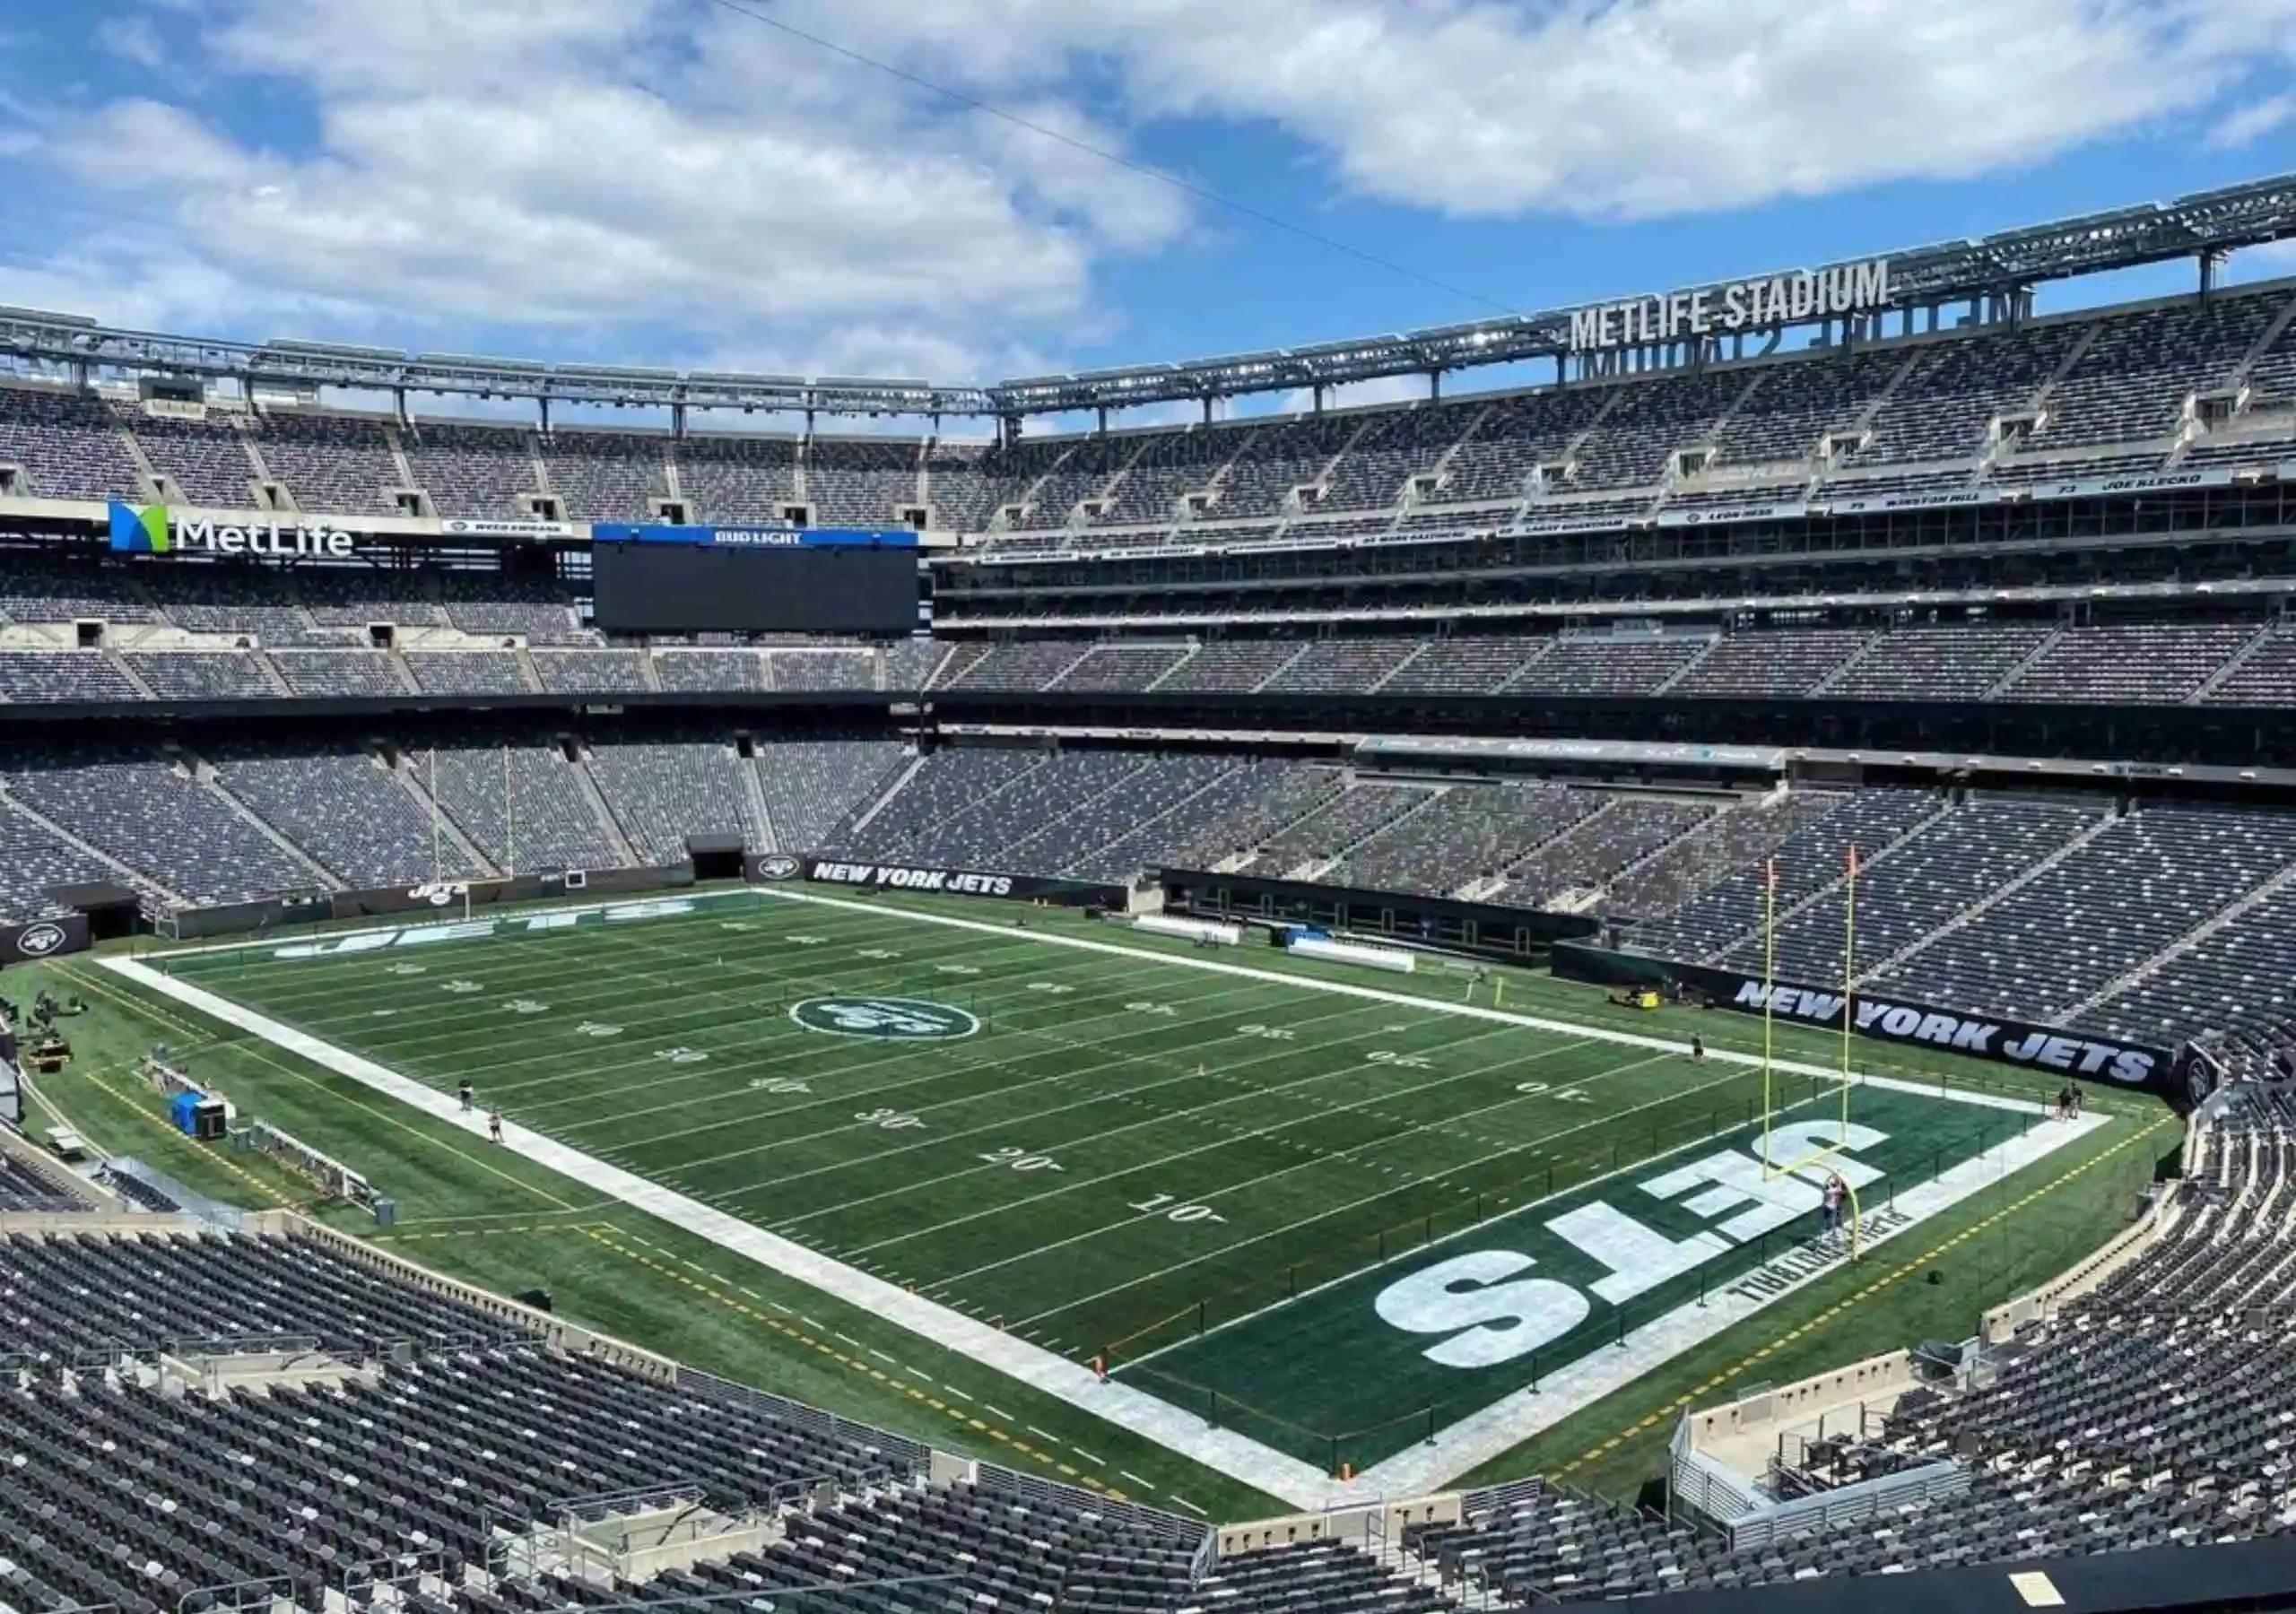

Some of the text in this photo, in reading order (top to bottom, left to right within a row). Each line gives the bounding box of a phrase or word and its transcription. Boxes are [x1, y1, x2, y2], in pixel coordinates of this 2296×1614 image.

[1570, 291, 1710, 351] METLIFE
[1724, 259, 1888, 327] STADIUM
[2102, 479, 2132, 491] JOE
[177, 517, 354, 556] MetLife
[715, 530, 803, 544] BUD LIGHT
[813, 862, 874, 883] NEW
[874, 866, 947, 889] YORK
[946, 874, 1013, 896] JETS
[1735, 979, 1845, 1021] NEW
[1852, 1001, 2005, 1053] YORK
[2003, 1032, 2155, 1083] JETS
[977, 1146, 1053, 1171] 20
[1127, 1193, 1213, 1222] 10
[1373, 1119, 1892, 1368] JETS
